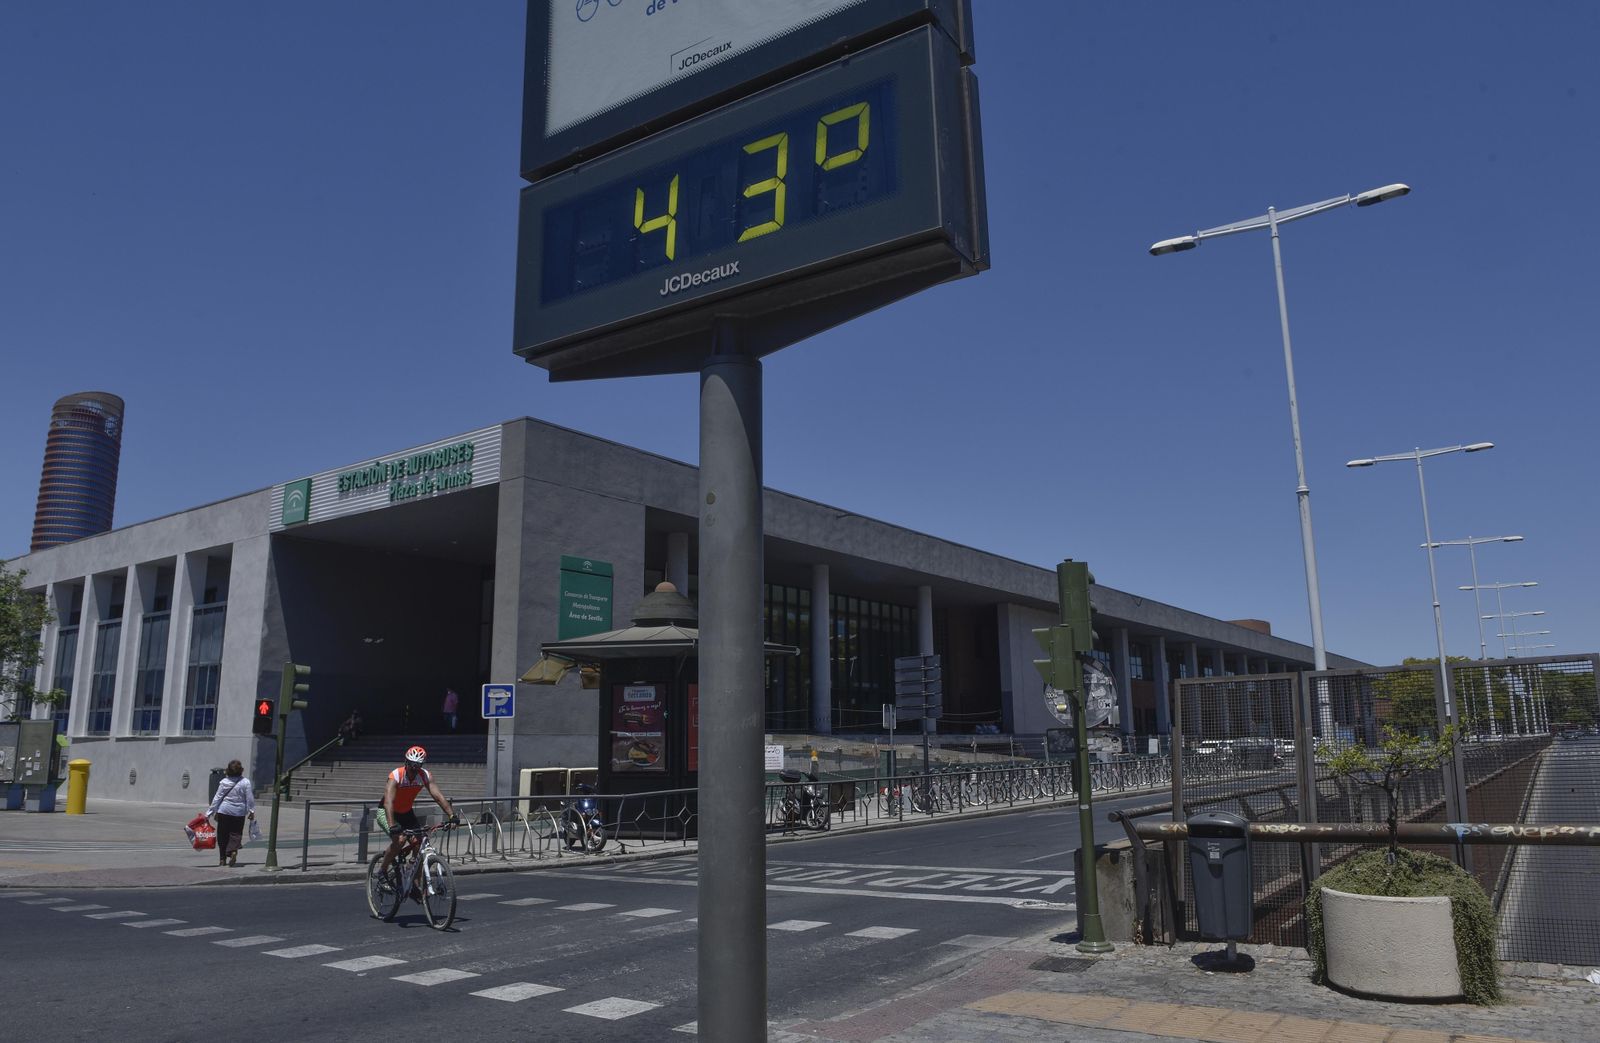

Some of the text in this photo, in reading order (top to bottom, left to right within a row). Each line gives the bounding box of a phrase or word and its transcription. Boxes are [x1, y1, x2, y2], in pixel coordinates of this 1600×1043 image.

[646, 0, 666, 16] de
[678, 41, 732, 70] JCDecaux
[660, 261, 740, 296] JCDecaux
[337, 441, 474, 492] ESTACIÓN DE AUTOBUSES
[389, 471, 473, 502] Plaza de Armas
